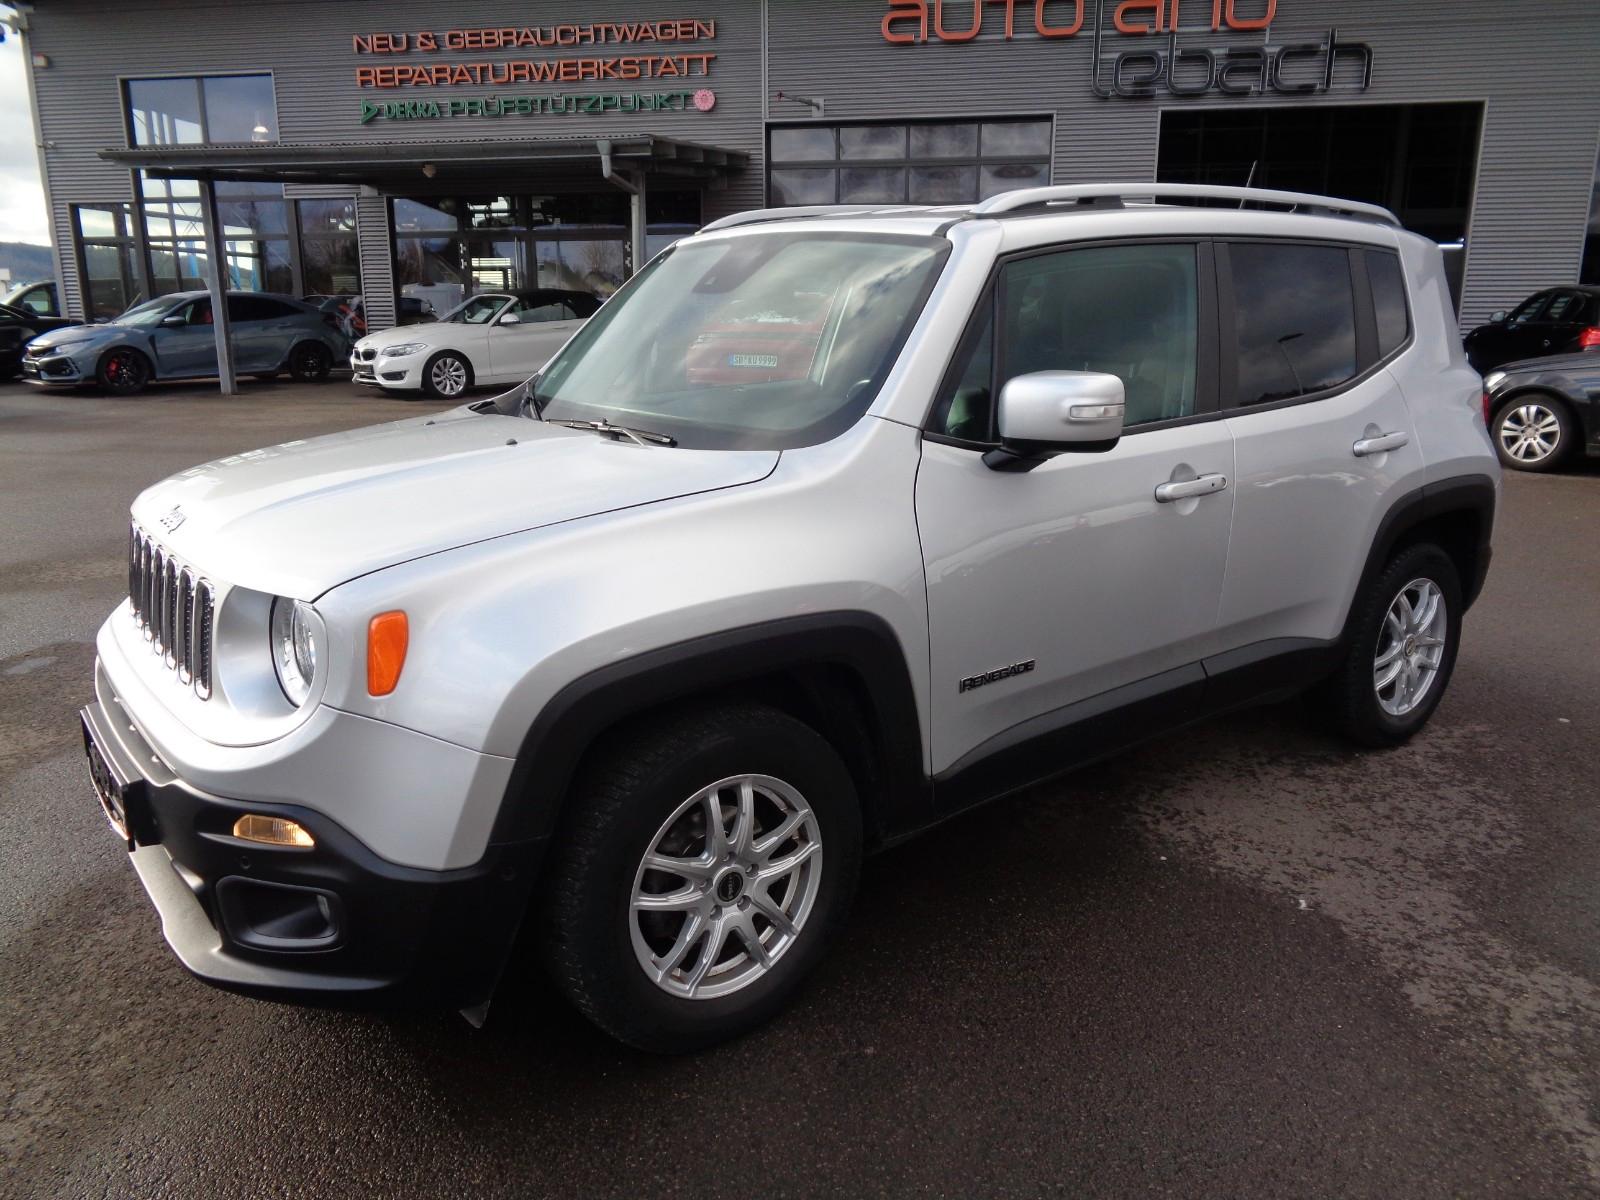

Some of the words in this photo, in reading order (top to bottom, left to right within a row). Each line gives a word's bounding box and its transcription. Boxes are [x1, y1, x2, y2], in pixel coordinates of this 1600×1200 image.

[353, 32, 407, 53] NEU
[417, 32, 437, 50] &
[445, 19, 714, 49] GEBRAUCHTWAGEN
[357, 53, 717, 87] REPARATURWERKSTATT
[384, 101, 440, 119] DEKRA
[450, 90, 691, 117] PRÜFSTÜTZPUNKT
[960, 659, 1036, 693] RENEGADE
